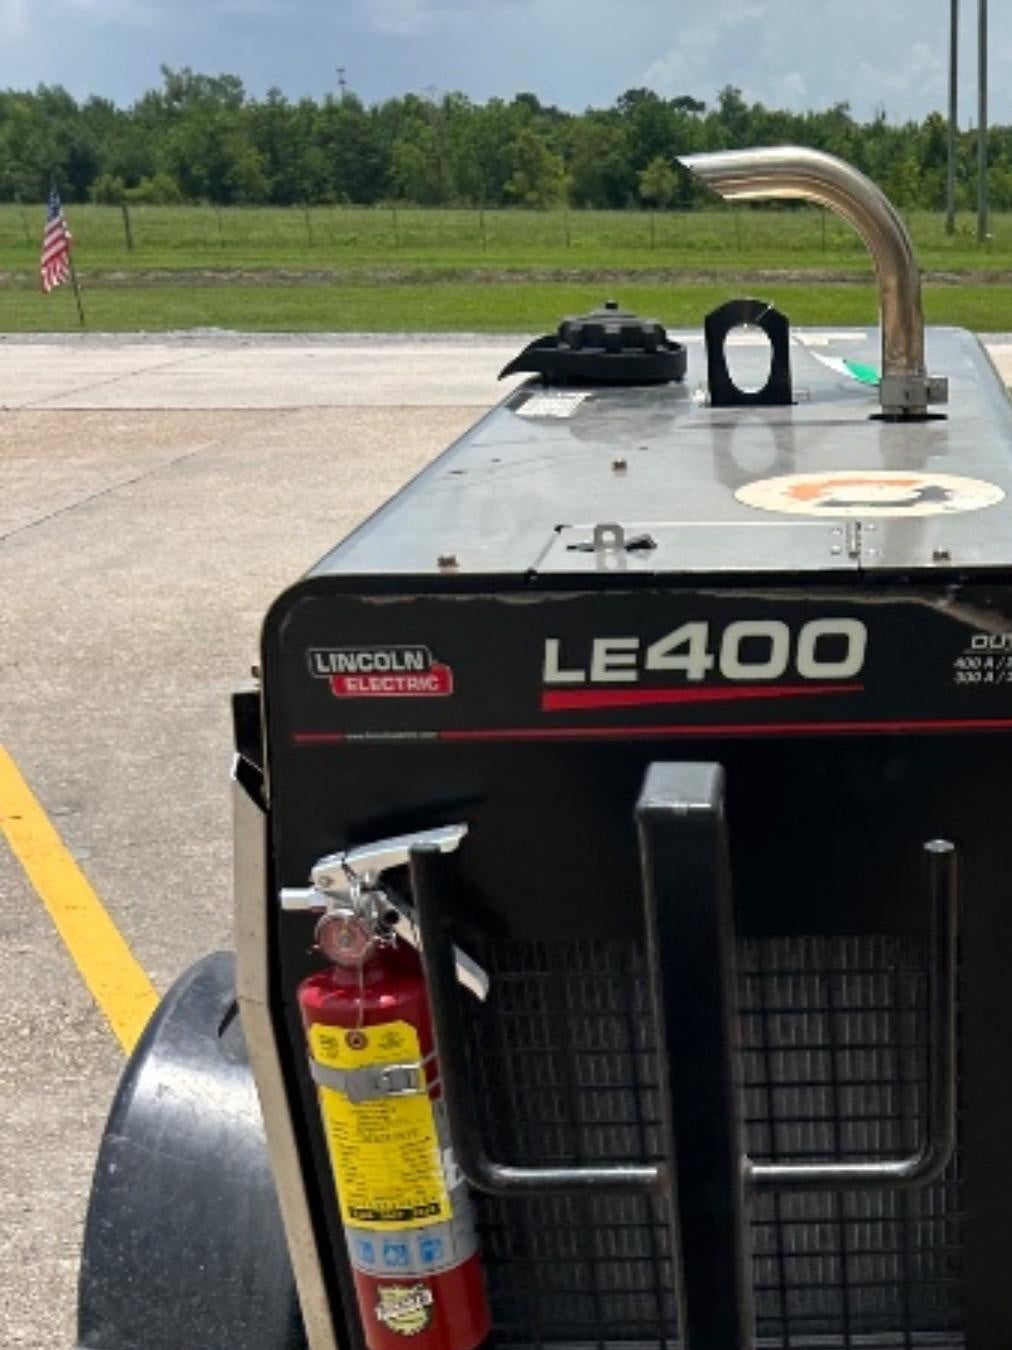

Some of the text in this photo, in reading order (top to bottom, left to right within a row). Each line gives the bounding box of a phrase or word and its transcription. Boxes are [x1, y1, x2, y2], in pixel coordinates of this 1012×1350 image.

[542, 617, 868, 683] LE400
[314, 651, 424, 673] LINCOLN
[345, 675, 438, 692] ELECTRIC
